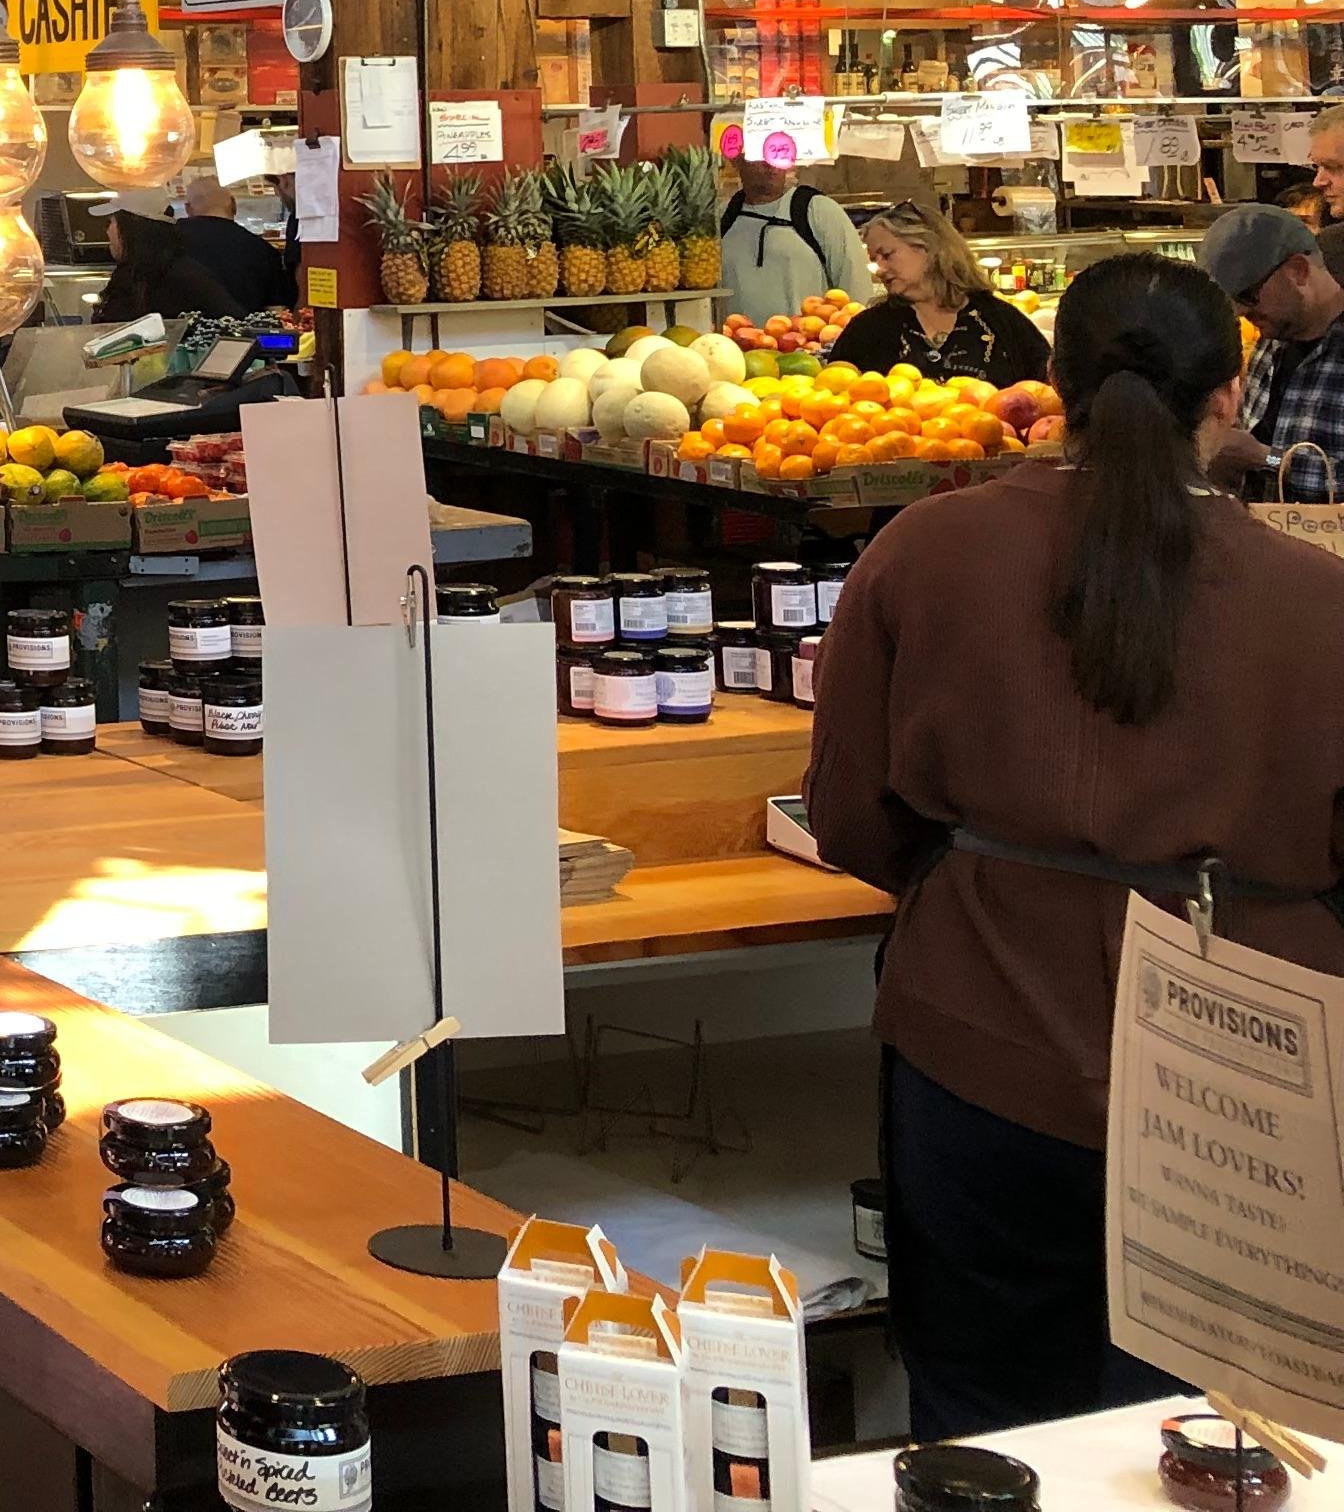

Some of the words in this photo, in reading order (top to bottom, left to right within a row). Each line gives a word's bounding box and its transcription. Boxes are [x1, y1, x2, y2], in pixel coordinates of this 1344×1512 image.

[1166, 979, 1299, 1057] PROVISIONS
[1154, 1061, 1283, 1141] WELCOME
[1141, 1107, 1187, 1151] JAM
[1192, 1131, 1306, 1201] LOVERS!
[255, 1456, 316, 1483] Spiced
